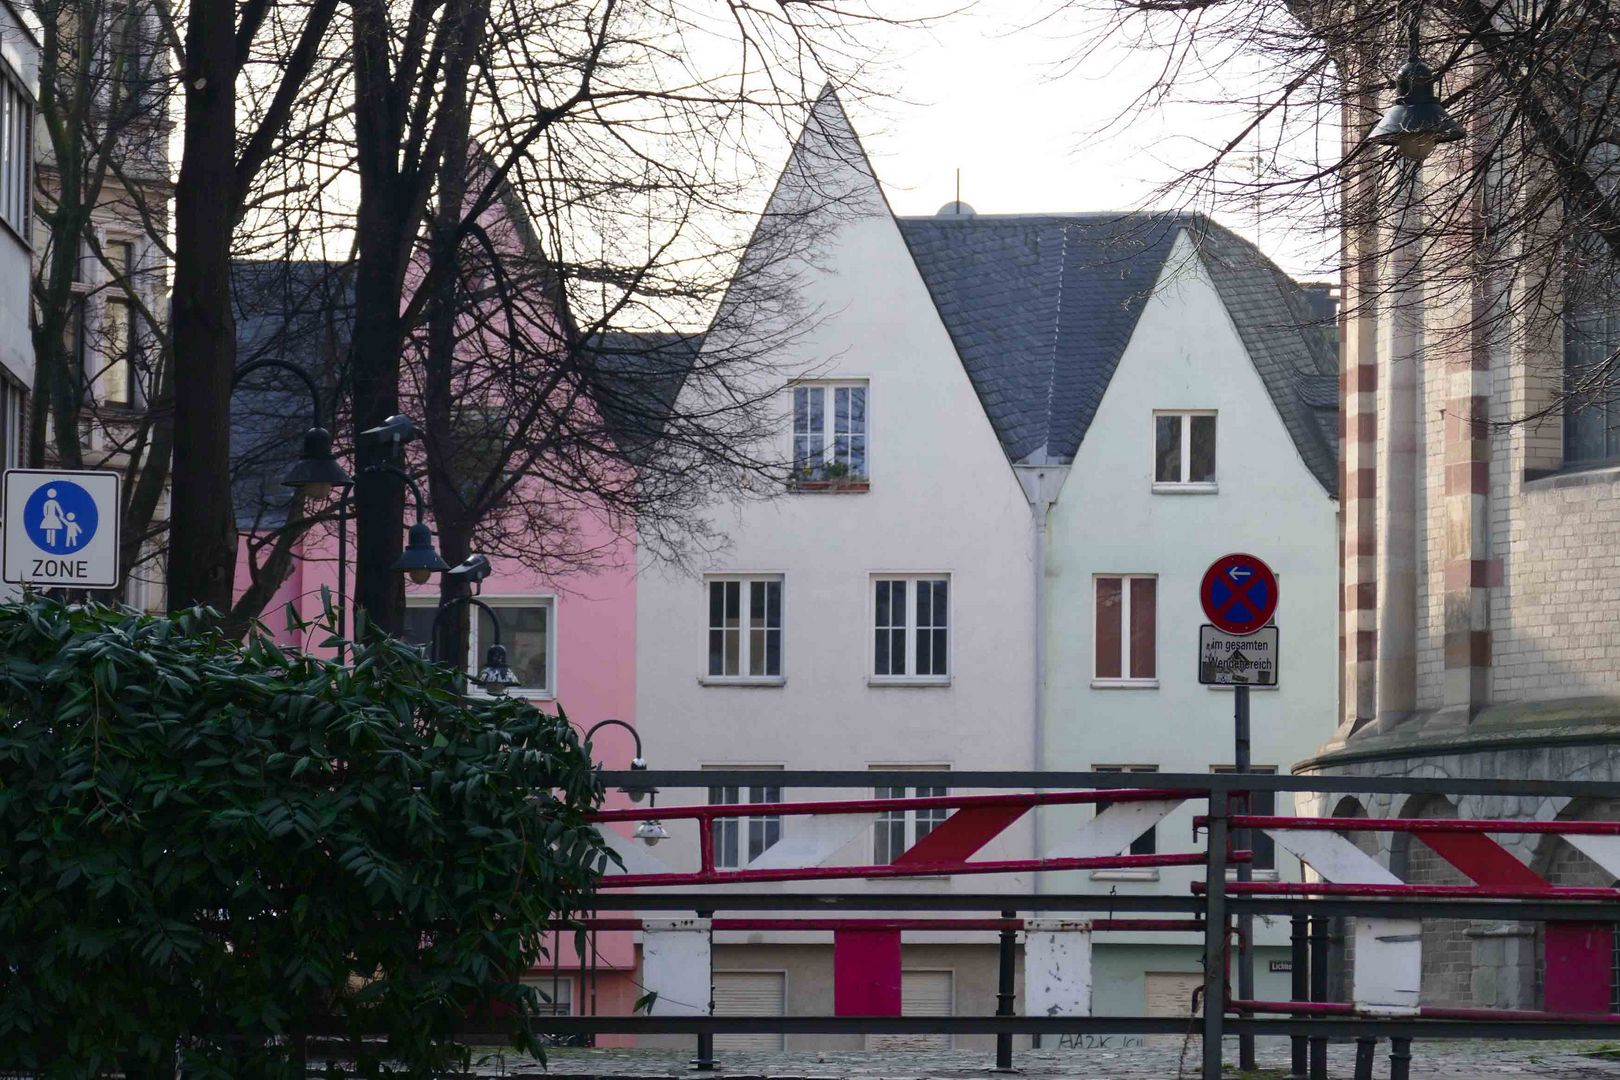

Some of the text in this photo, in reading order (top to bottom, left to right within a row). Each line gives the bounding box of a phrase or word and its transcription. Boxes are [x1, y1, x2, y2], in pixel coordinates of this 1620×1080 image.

[32, 559, 88, 578] ZONE
[1211, 639, 1268, 653] im gesamten
